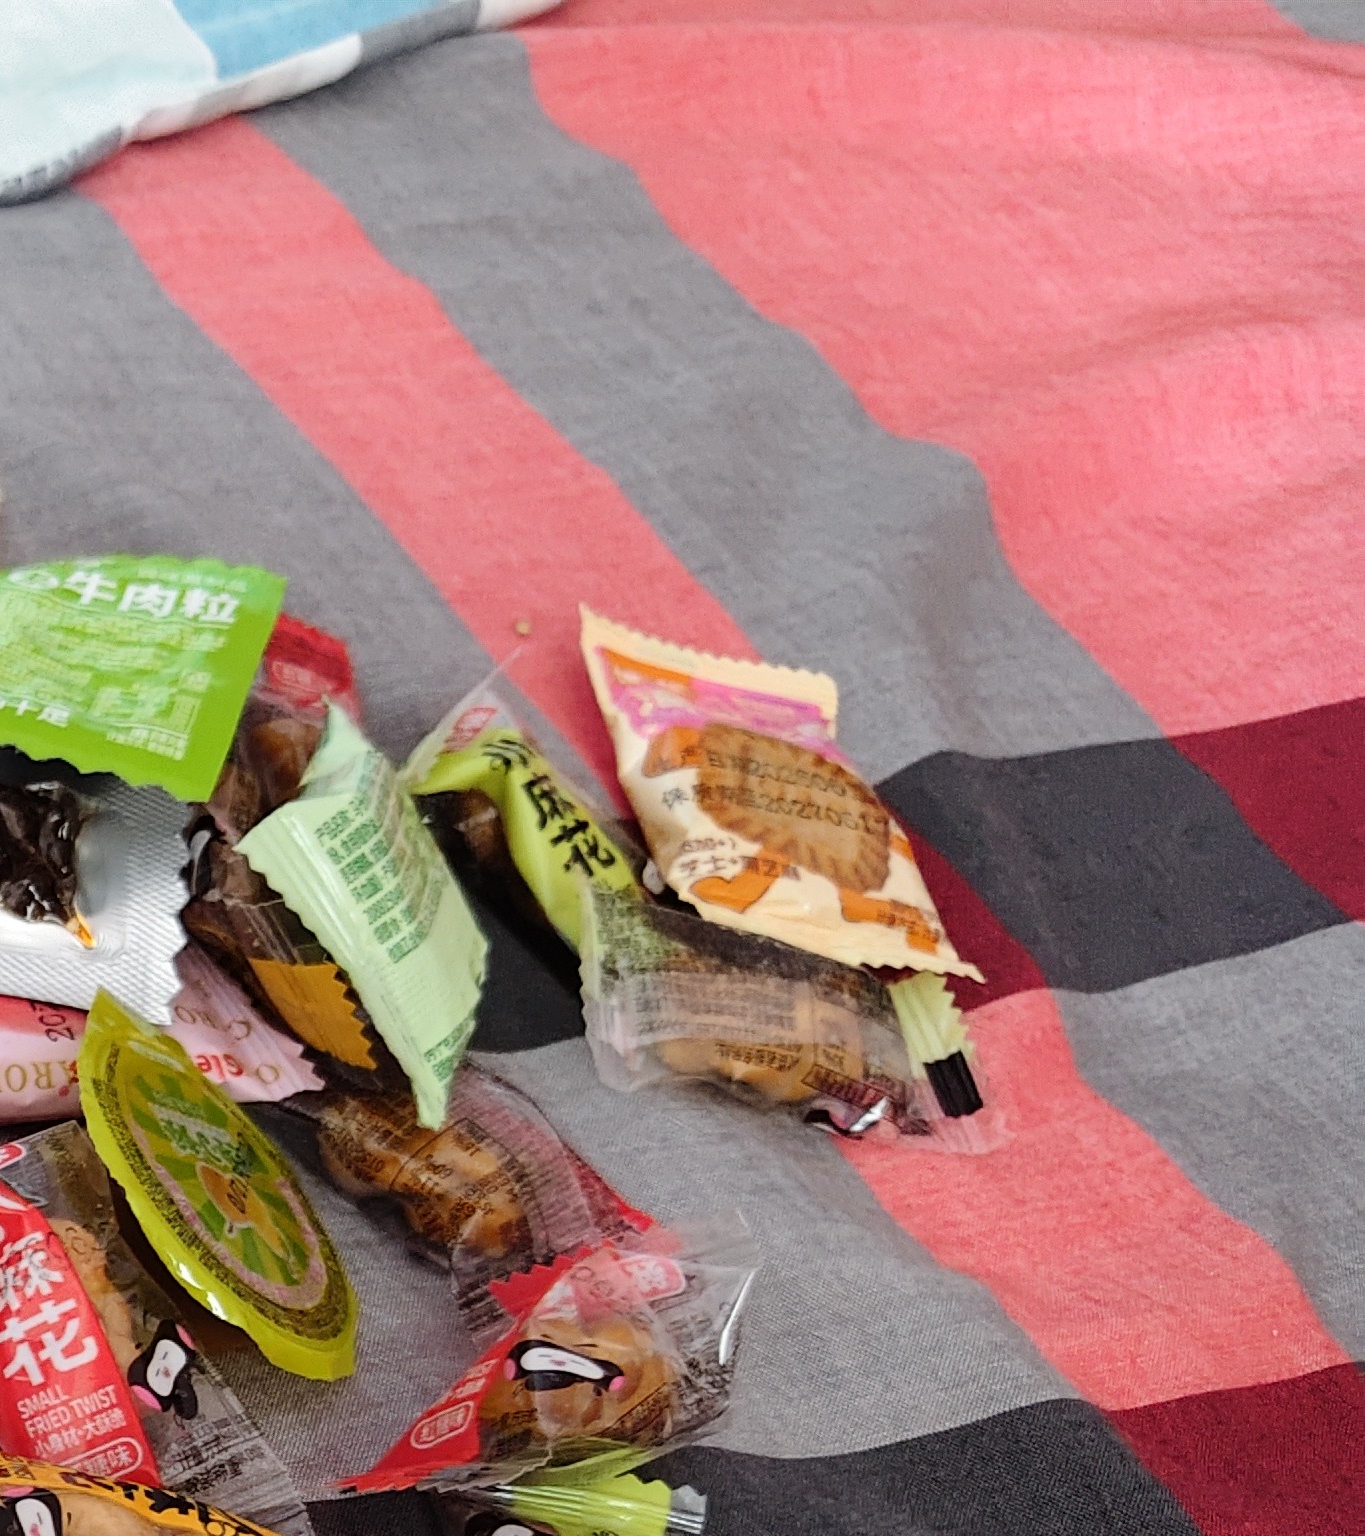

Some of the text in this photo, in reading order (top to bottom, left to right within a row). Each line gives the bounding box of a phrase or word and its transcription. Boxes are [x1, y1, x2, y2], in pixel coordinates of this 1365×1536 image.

[64, 570, 240, 626] 牛肉粒
[17, 1385, 70, 1420] SMALL
[25, 1385, 119, 1436] FRIED TWIST
